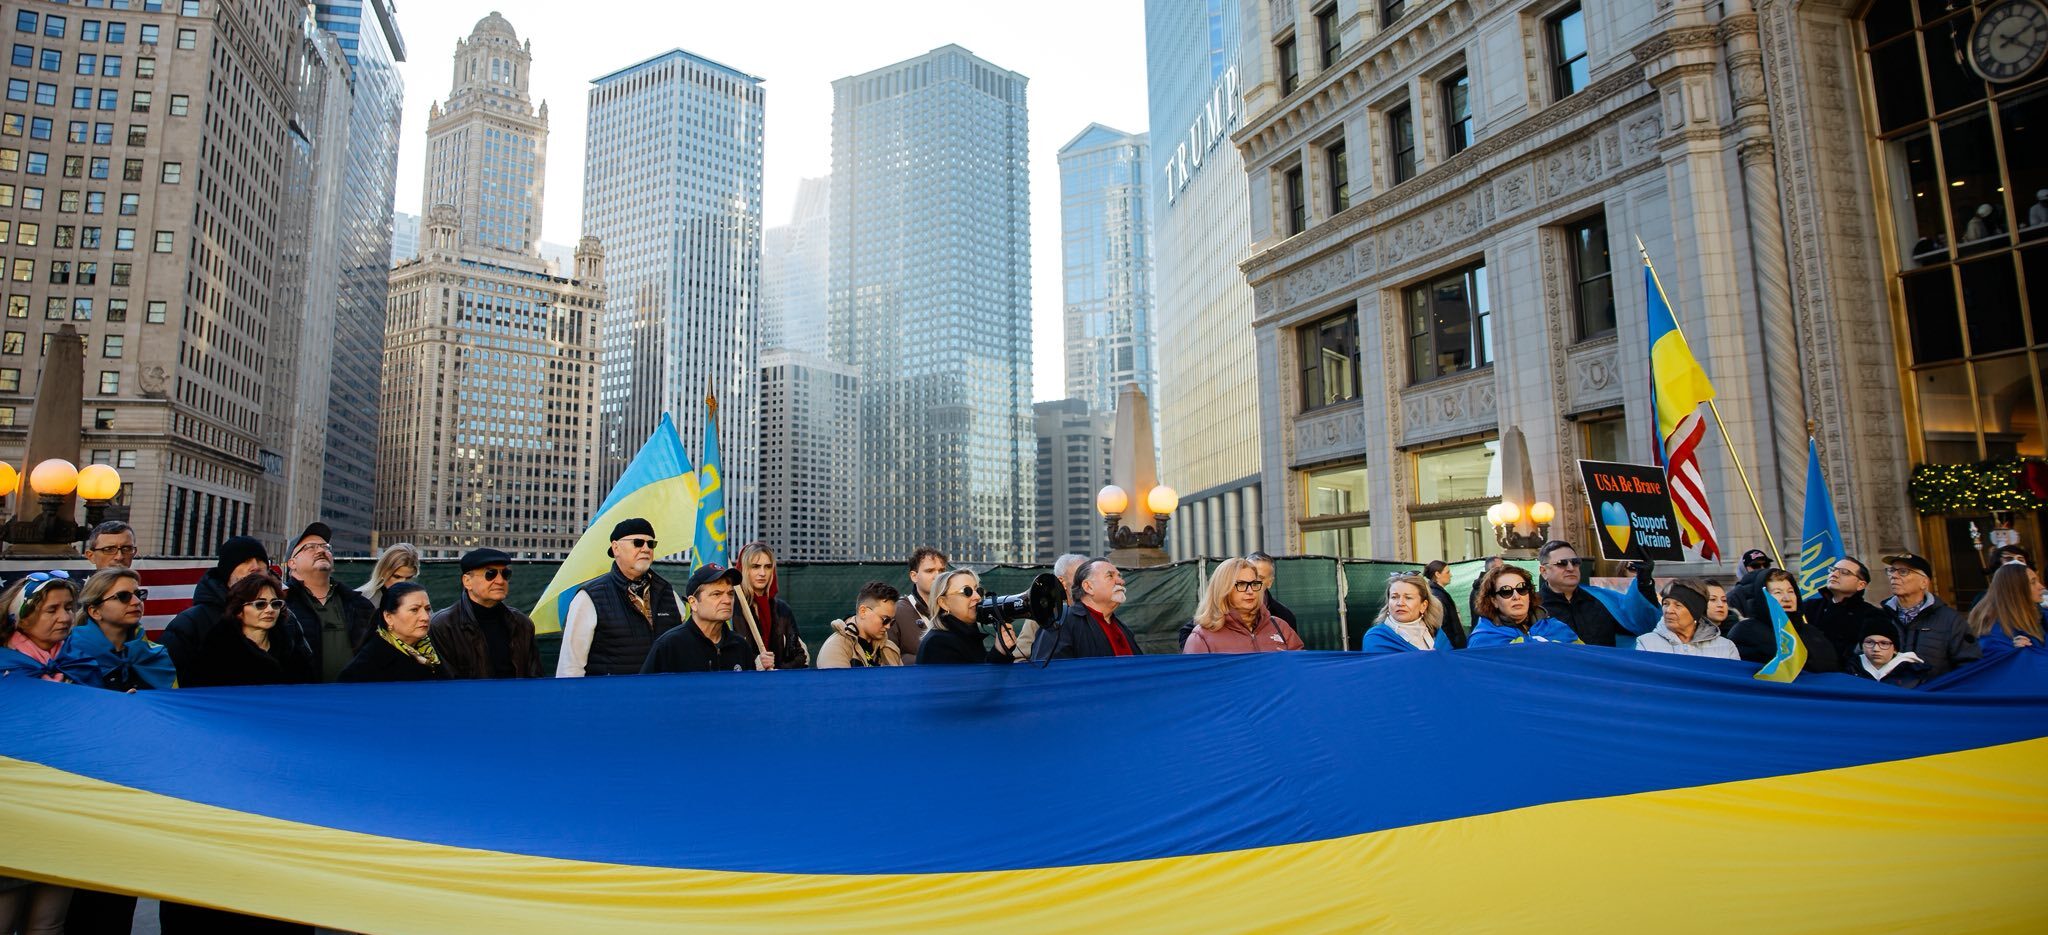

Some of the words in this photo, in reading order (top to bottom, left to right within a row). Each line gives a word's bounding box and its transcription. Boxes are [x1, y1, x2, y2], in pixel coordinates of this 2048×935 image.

[1165, 66, 1239, 204] TRUMP
[1594, 473, 1620, 492] USA
[1618, 475, 1633, 493] Be
[1632, 476, 1661, 495] Brave
[1630, 511, 1669, 533] Support
[1635, 530, 1671, 548] Ukraine
